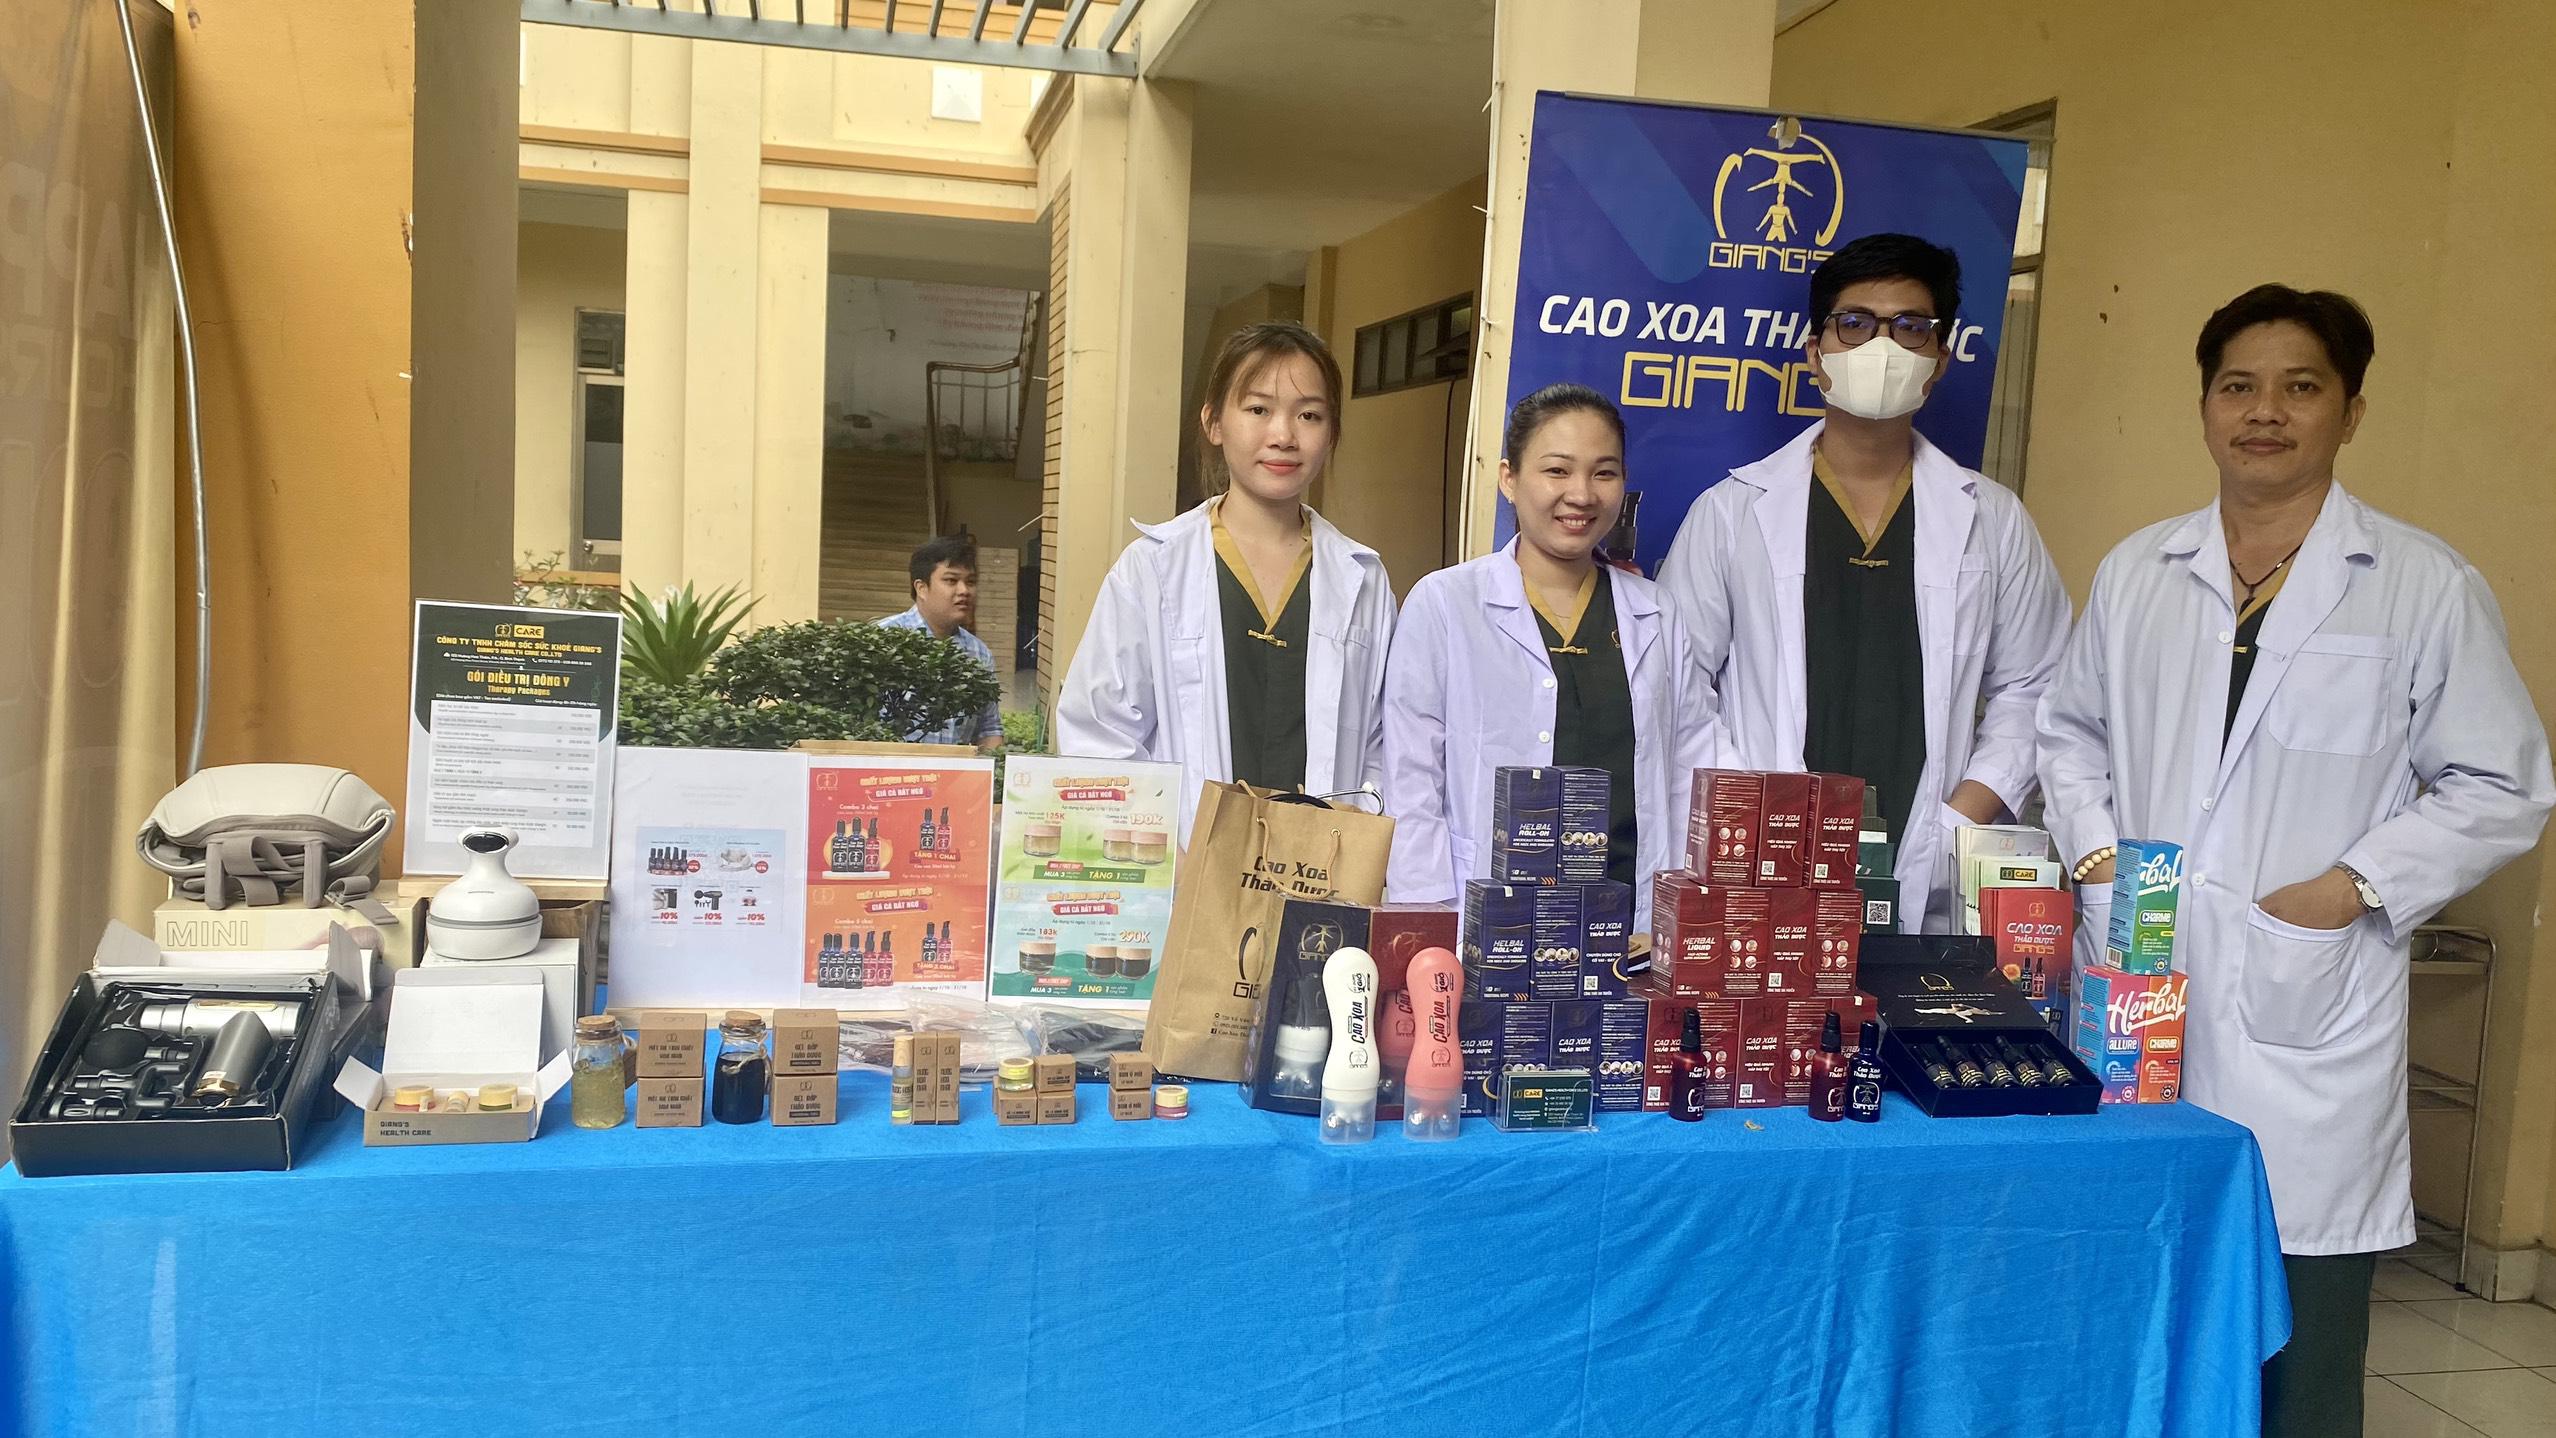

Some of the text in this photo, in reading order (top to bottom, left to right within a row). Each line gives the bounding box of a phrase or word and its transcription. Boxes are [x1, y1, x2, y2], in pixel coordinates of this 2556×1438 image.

[1539, 294, 1631, 337] CAO
[1636, 301, 1727, 345] XOA
[516, 626, 542, 636] CARE
[467, 670, 484, 682] GÓI
[488, 667, 511, 684] ĐIỀU
[514, 673, 530, 686] TRỊ
[533, 674, 560, 687] ĐÔNG
[488, 684, 551, 696] Therapy Packages
[1519, 823, 1552, 831] HELBAL
[1089, 871, 1113, 880] TẶNG
[1292, 862, 1328, 881] Xoa
[2015, 871, 2034, 879] CARE
[2139, 850, 2183, 893] bal
[660, 912, 678, 920] 10%
[747, 913, 765, 921] 10%
[167, 920, 249, 947] MINI
[1775, 926, 1790, 934] CAO
[2006, 923, 2063, 936] CAO XOA
[1120, 929, 1151, 943] 290K
[1683, 937, 1716, 945] HERBAL
[2014, 935, 2055, 945] THẢO DƯỢC
[1078, 985, 1102, 994] TẶNG
[2107, 979, 2188, 1035] Herbal
[1351, 1001, 1365, 1044] CAO XOA
[1433, 1001, 1447, 1043] CAO XOA
[1654, 1039, 1669, 1047] CAO
